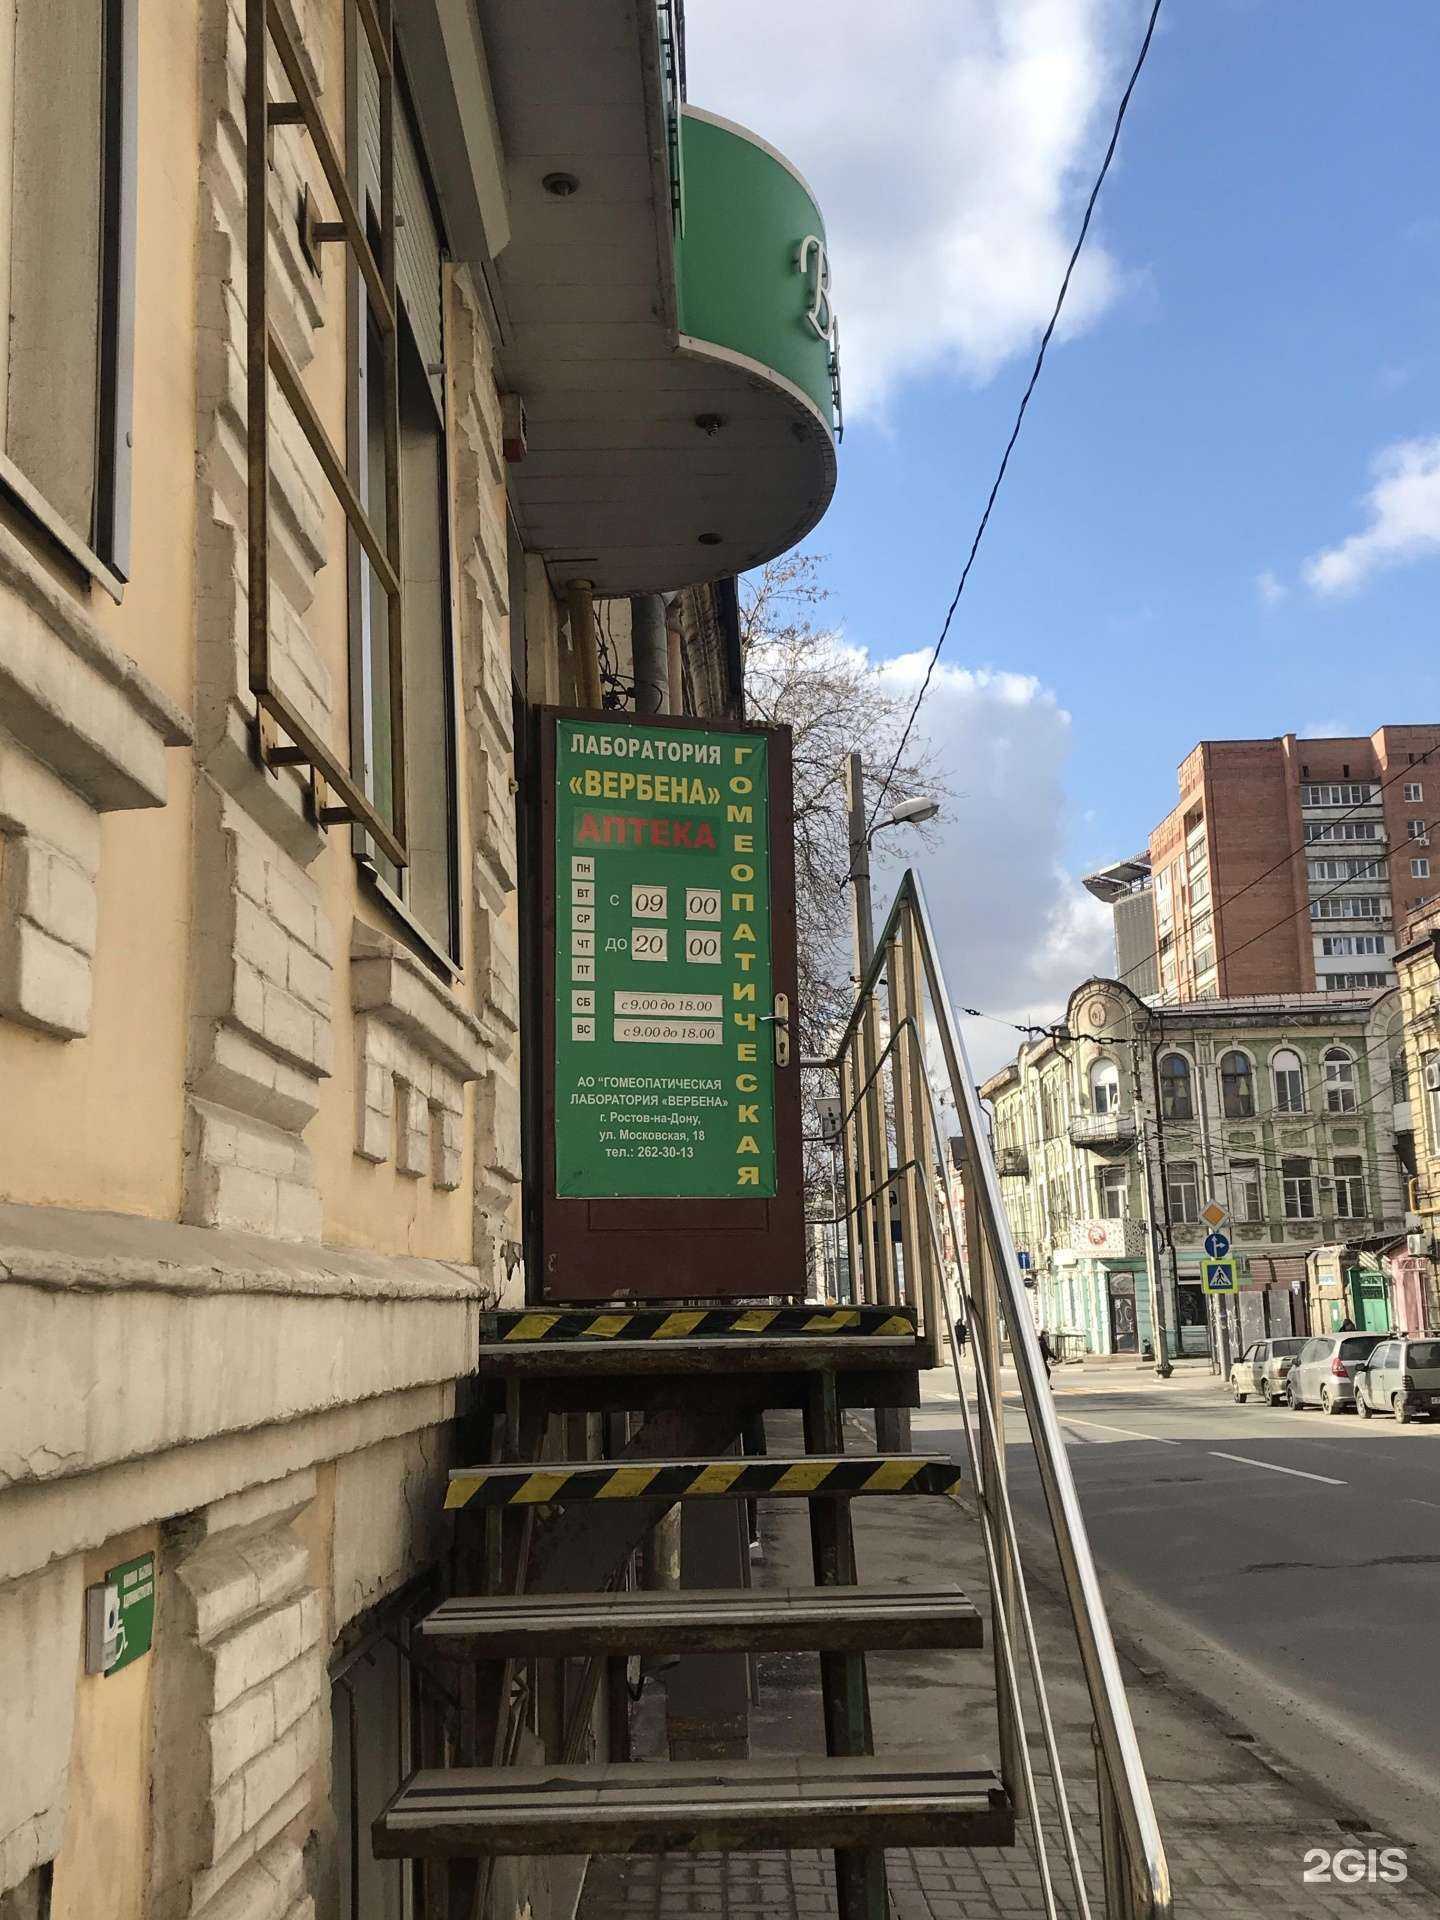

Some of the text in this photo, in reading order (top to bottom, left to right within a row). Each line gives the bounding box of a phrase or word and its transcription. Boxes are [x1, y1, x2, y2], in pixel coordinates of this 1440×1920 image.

[570, 733, 721, 765] ЛАБОРАТОРИЯ
[569, 769, 721, 805] «ВЕРБЕНА»
[577, 811, 717, 849] АПТЕКА
[576, 863, 592, 874] ПН
[576, 888, 591, 899] ВТ
[635, 893, 664, 912] 09
[689, 896, 718, 915] 00
[576, 914, 591, 924] СР
[576, 939, 591, 950] ЧТ
[634, 934, 664, 954] 20
[689, 937, 718, 957] 00
[576, 964, 591, 975] ПТ
[727, 747, 761, 1185] ГОМЕОПАТИЧЕСКАЯ
[576, 997, 591, 1007] СБ
[621, 999, 713, 1012] с 9.00 до 18.00
[576, 1024, 591, 1034] ВС
[623, 1026, 715, 1039] с 9.00 до 18.00
[577, 1076, 595, 1088] АО
[570, 1093, 729, 1107] ЛАБОРАТОРИЯ «ВЕРБЕНА»
[600, 1113, 607, 1123] г.
[599, 1129, 705, 1142] ул. Московская, 18
[605, 1146, 694, 1158] тел.: 262-30-13
